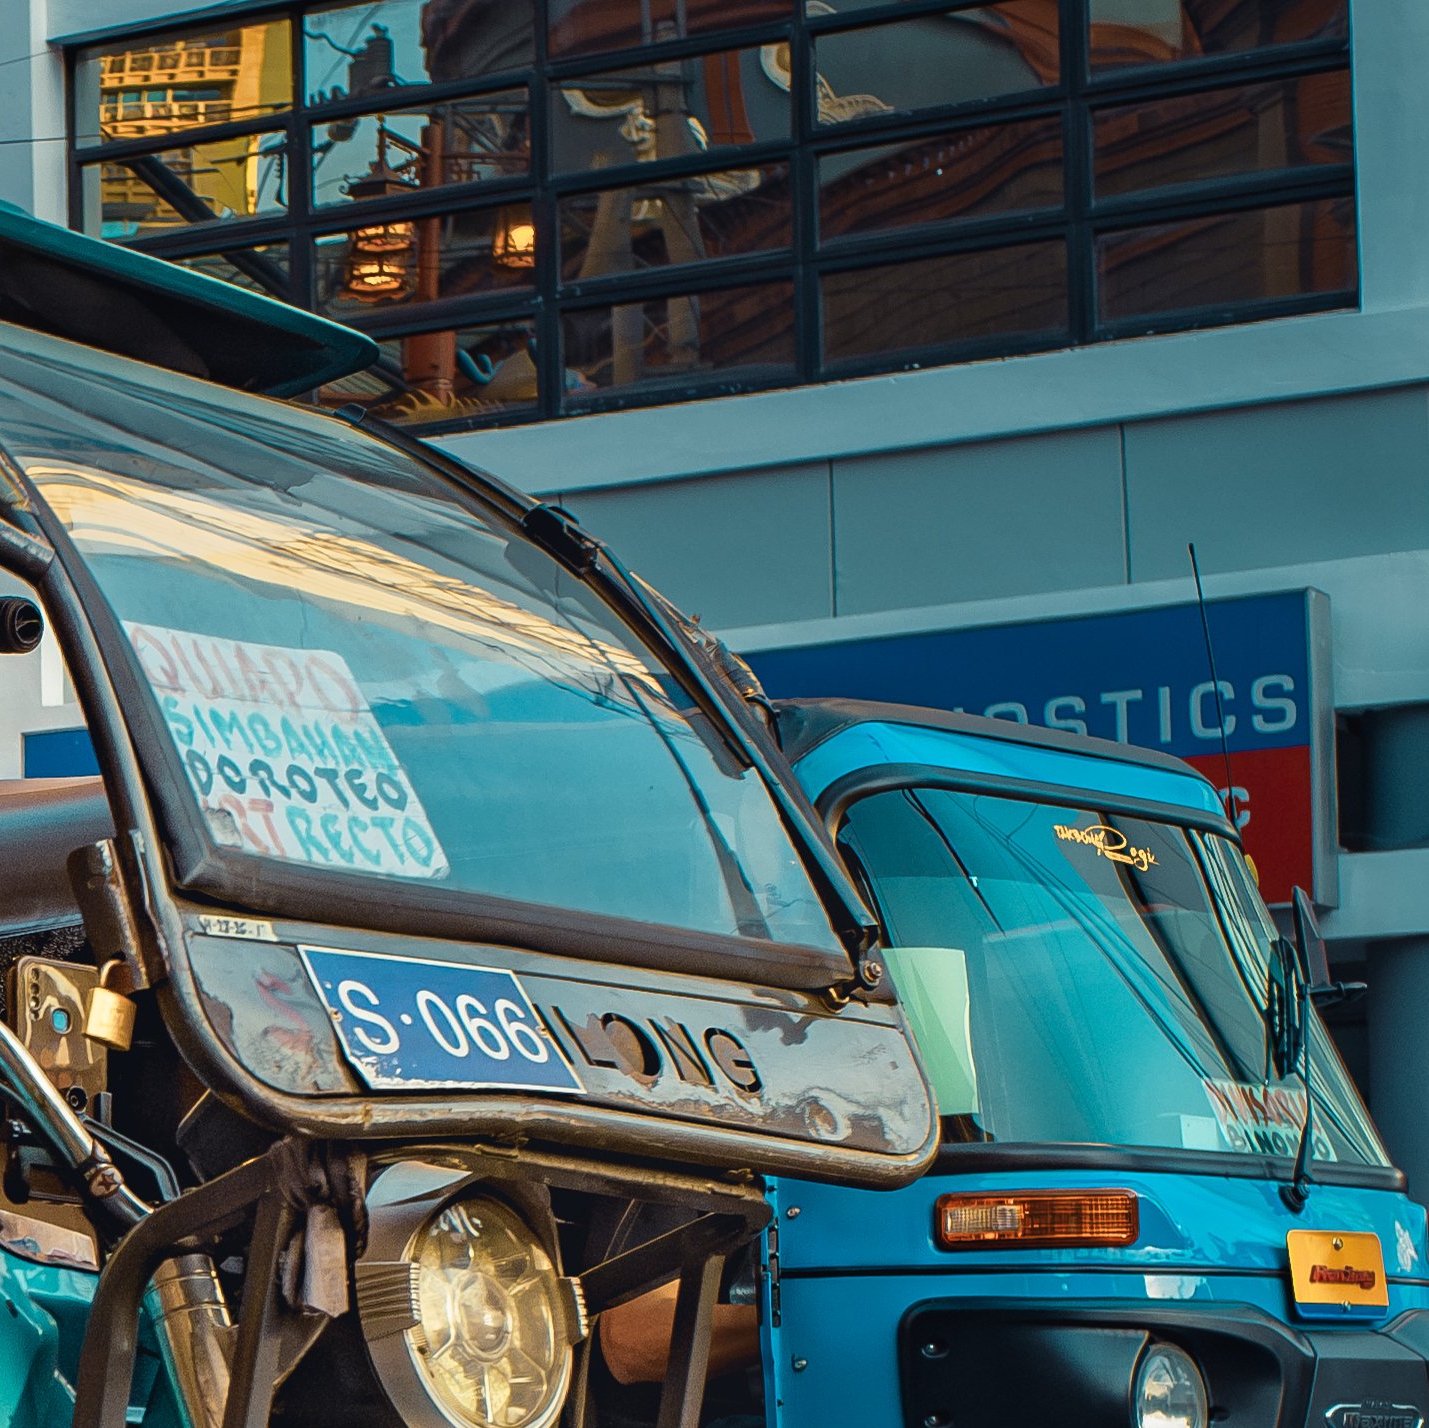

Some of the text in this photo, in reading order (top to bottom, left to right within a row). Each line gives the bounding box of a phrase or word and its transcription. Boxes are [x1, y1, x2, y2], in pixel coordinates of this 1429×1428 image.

[130, 627, 360, 724] QUIAPO
[162, 694, 395, 772] SIMBAHAN
[185, 748, 408, 812] DOROTEO
[287, 808, 434, 867] RECTO
[1227, 1124, 1331, 1160] BINONO
